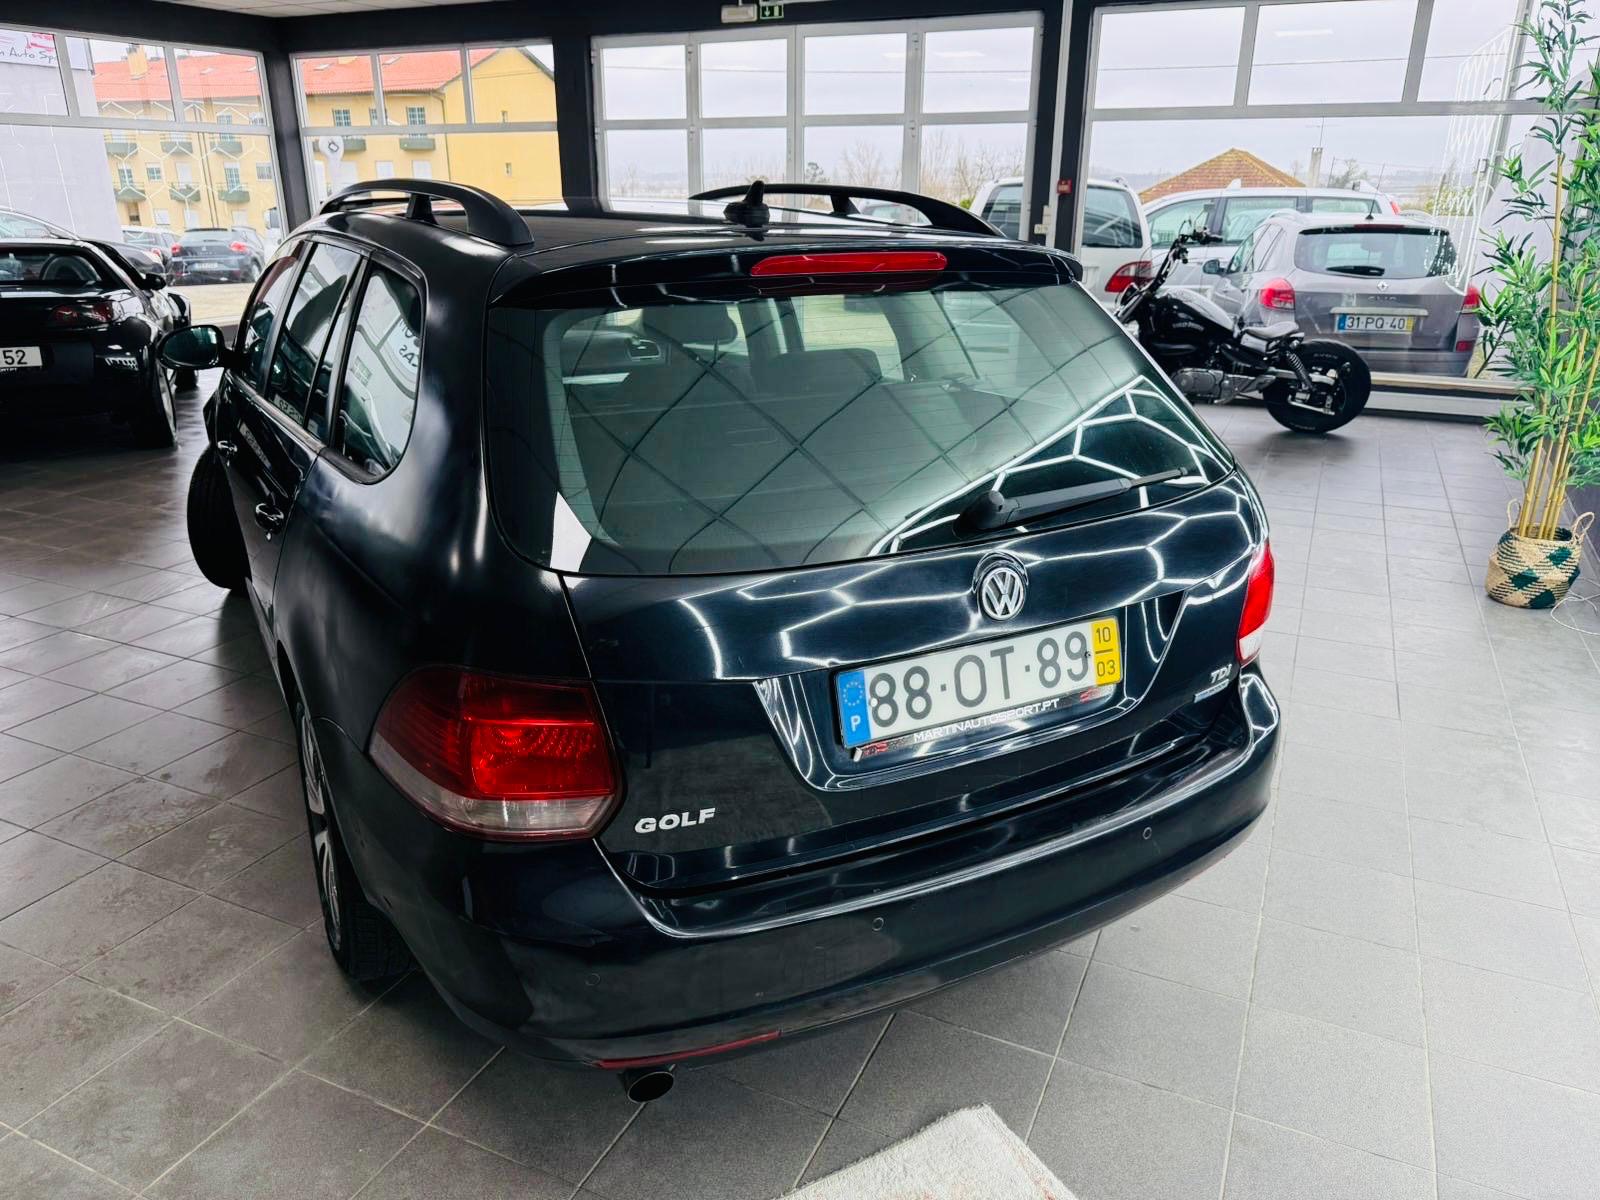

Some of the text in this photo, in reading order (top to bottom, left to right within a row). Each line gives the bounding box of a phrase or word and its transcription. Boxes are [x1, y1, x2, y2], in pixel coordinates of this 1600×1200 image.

[10, 47, 35, 58] Auto
[2, 350, 28, 366] 52
[1095, 626, 1112, 644] 10
[1096, 659, 1116, 677] 03
[850, 715, 861, 732] P
[634, 807, 716, 834] GOLF
